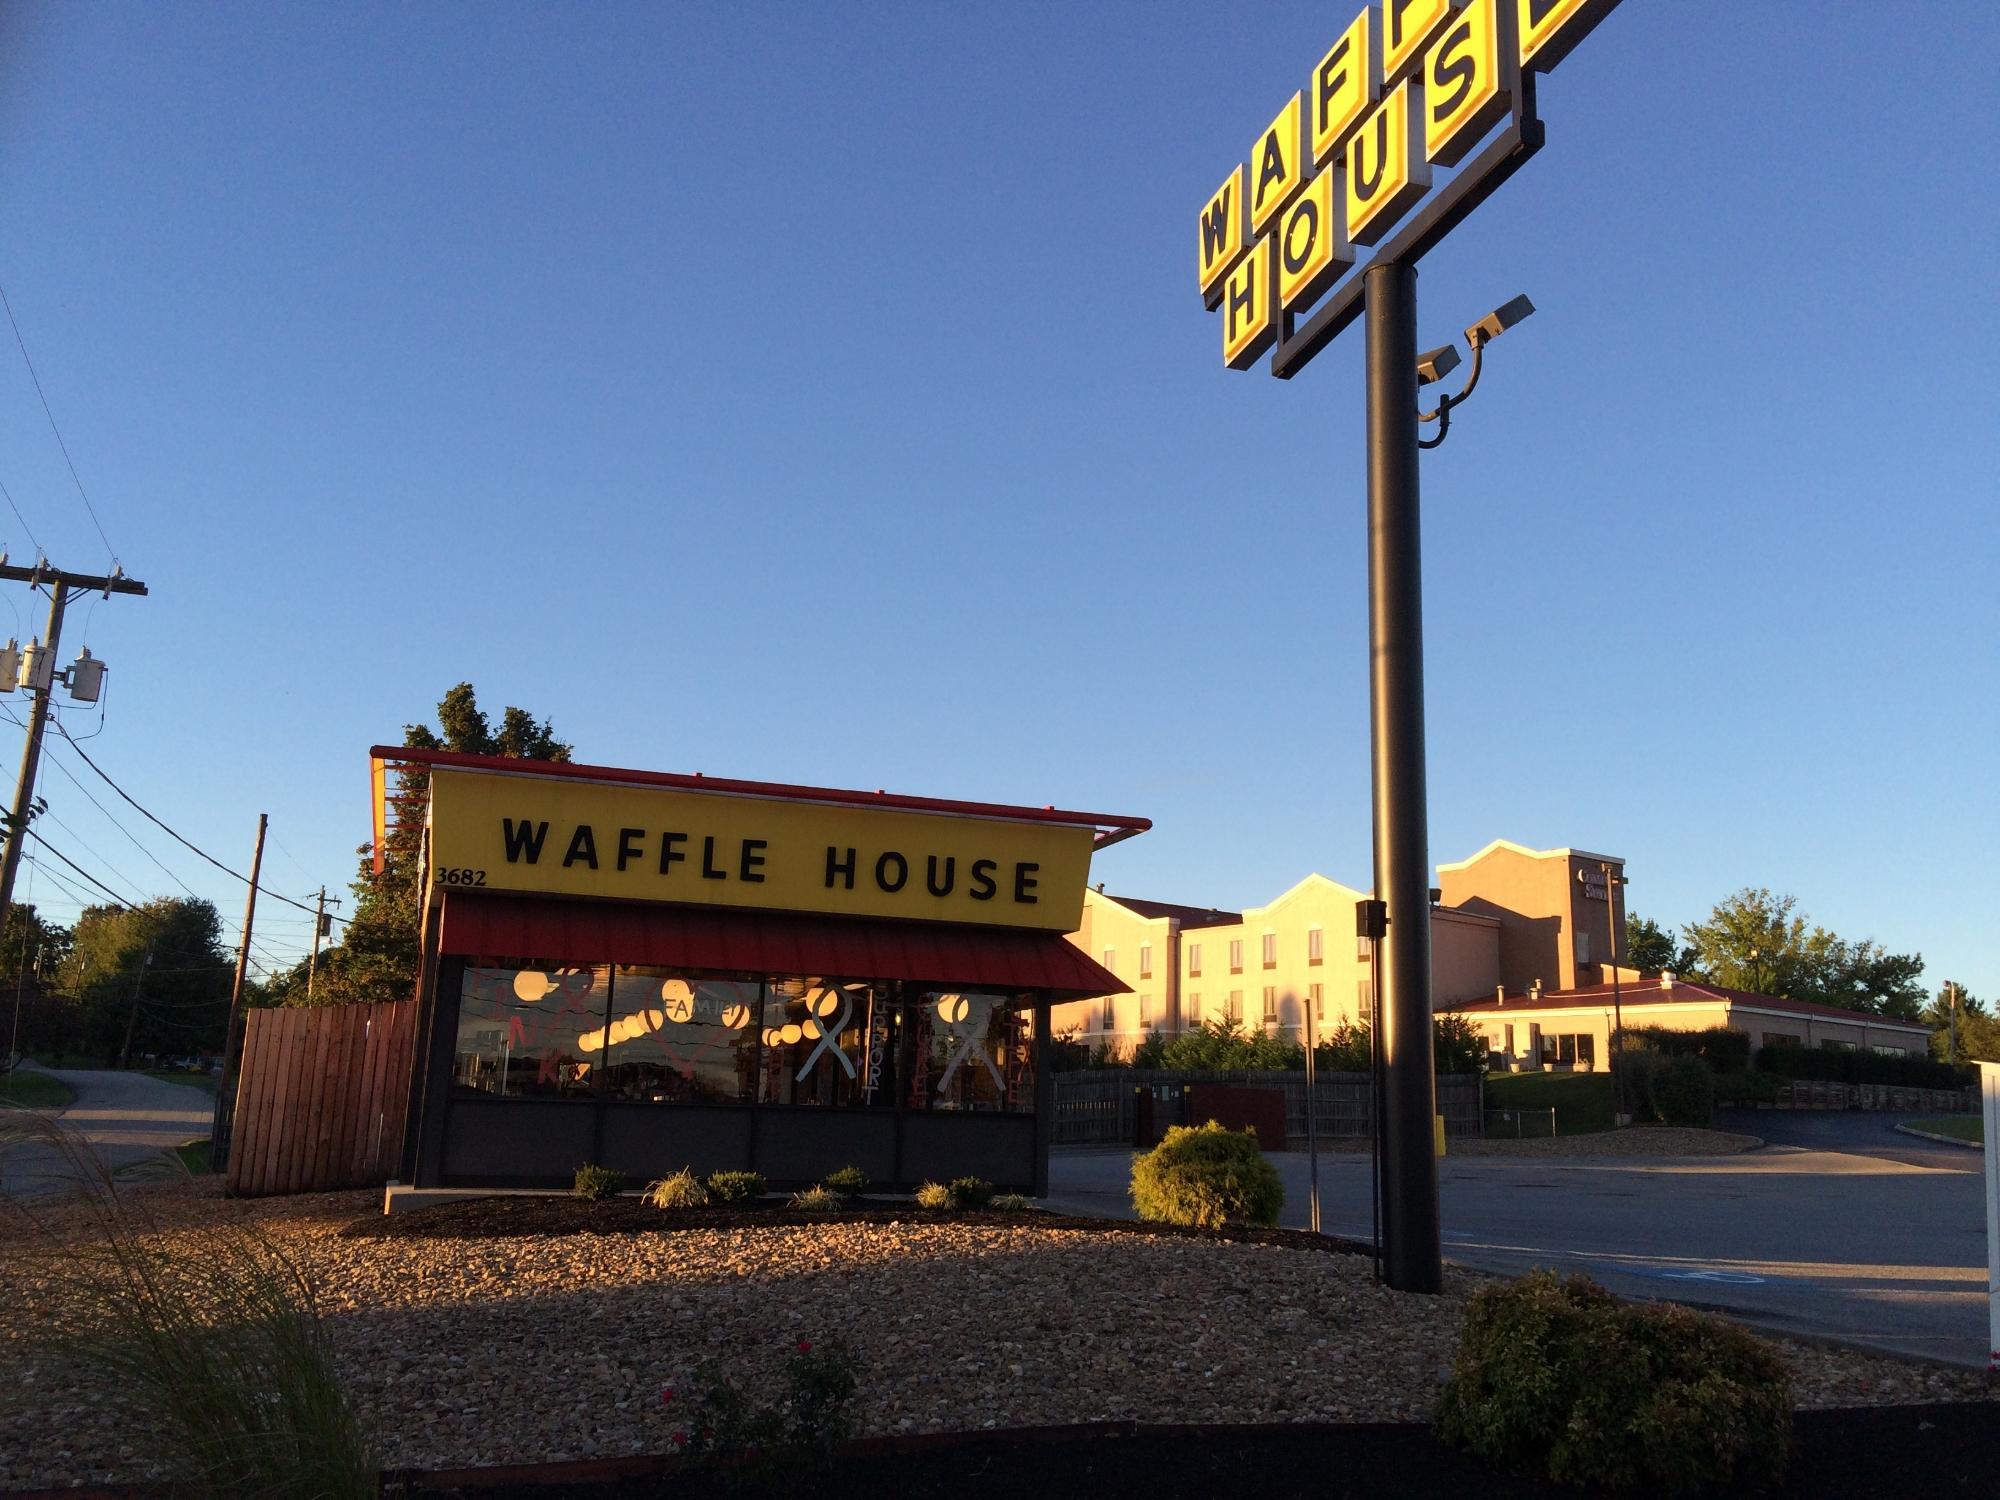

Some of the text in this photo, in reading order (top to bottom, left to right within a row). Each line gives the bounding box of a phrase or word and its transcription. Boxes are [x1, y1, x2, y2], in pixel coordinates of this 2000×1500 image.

[1228, 0, 1554, 345] HOUS
[435, 867, 487, 886] 3682
[503, 818, 1039, 904] WAFFLE HOUSE
[861, 984, 889, 1105] SUPPORT
